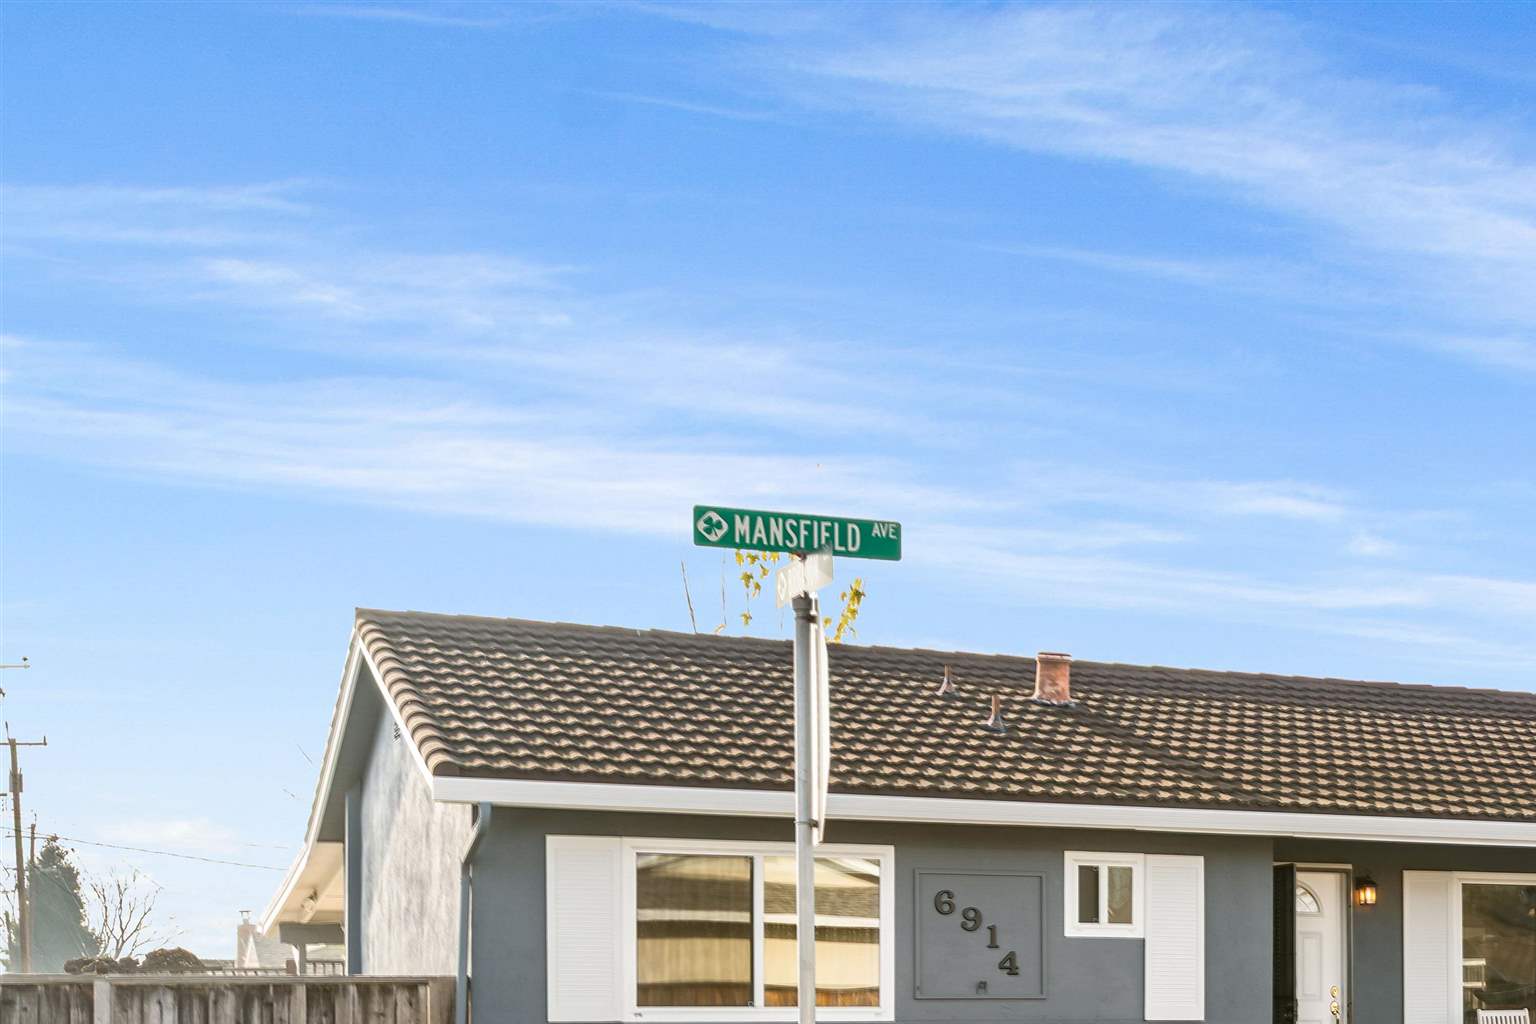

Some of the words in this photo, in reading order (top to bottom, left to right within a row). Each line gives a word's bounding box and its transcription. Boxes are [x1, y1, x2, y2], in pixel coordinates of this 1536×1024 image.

[733, 513, 861, 552] MANSFIELD
[871, 522, 898, 540] AVE
[934, 889, 1020, 976] 6914
